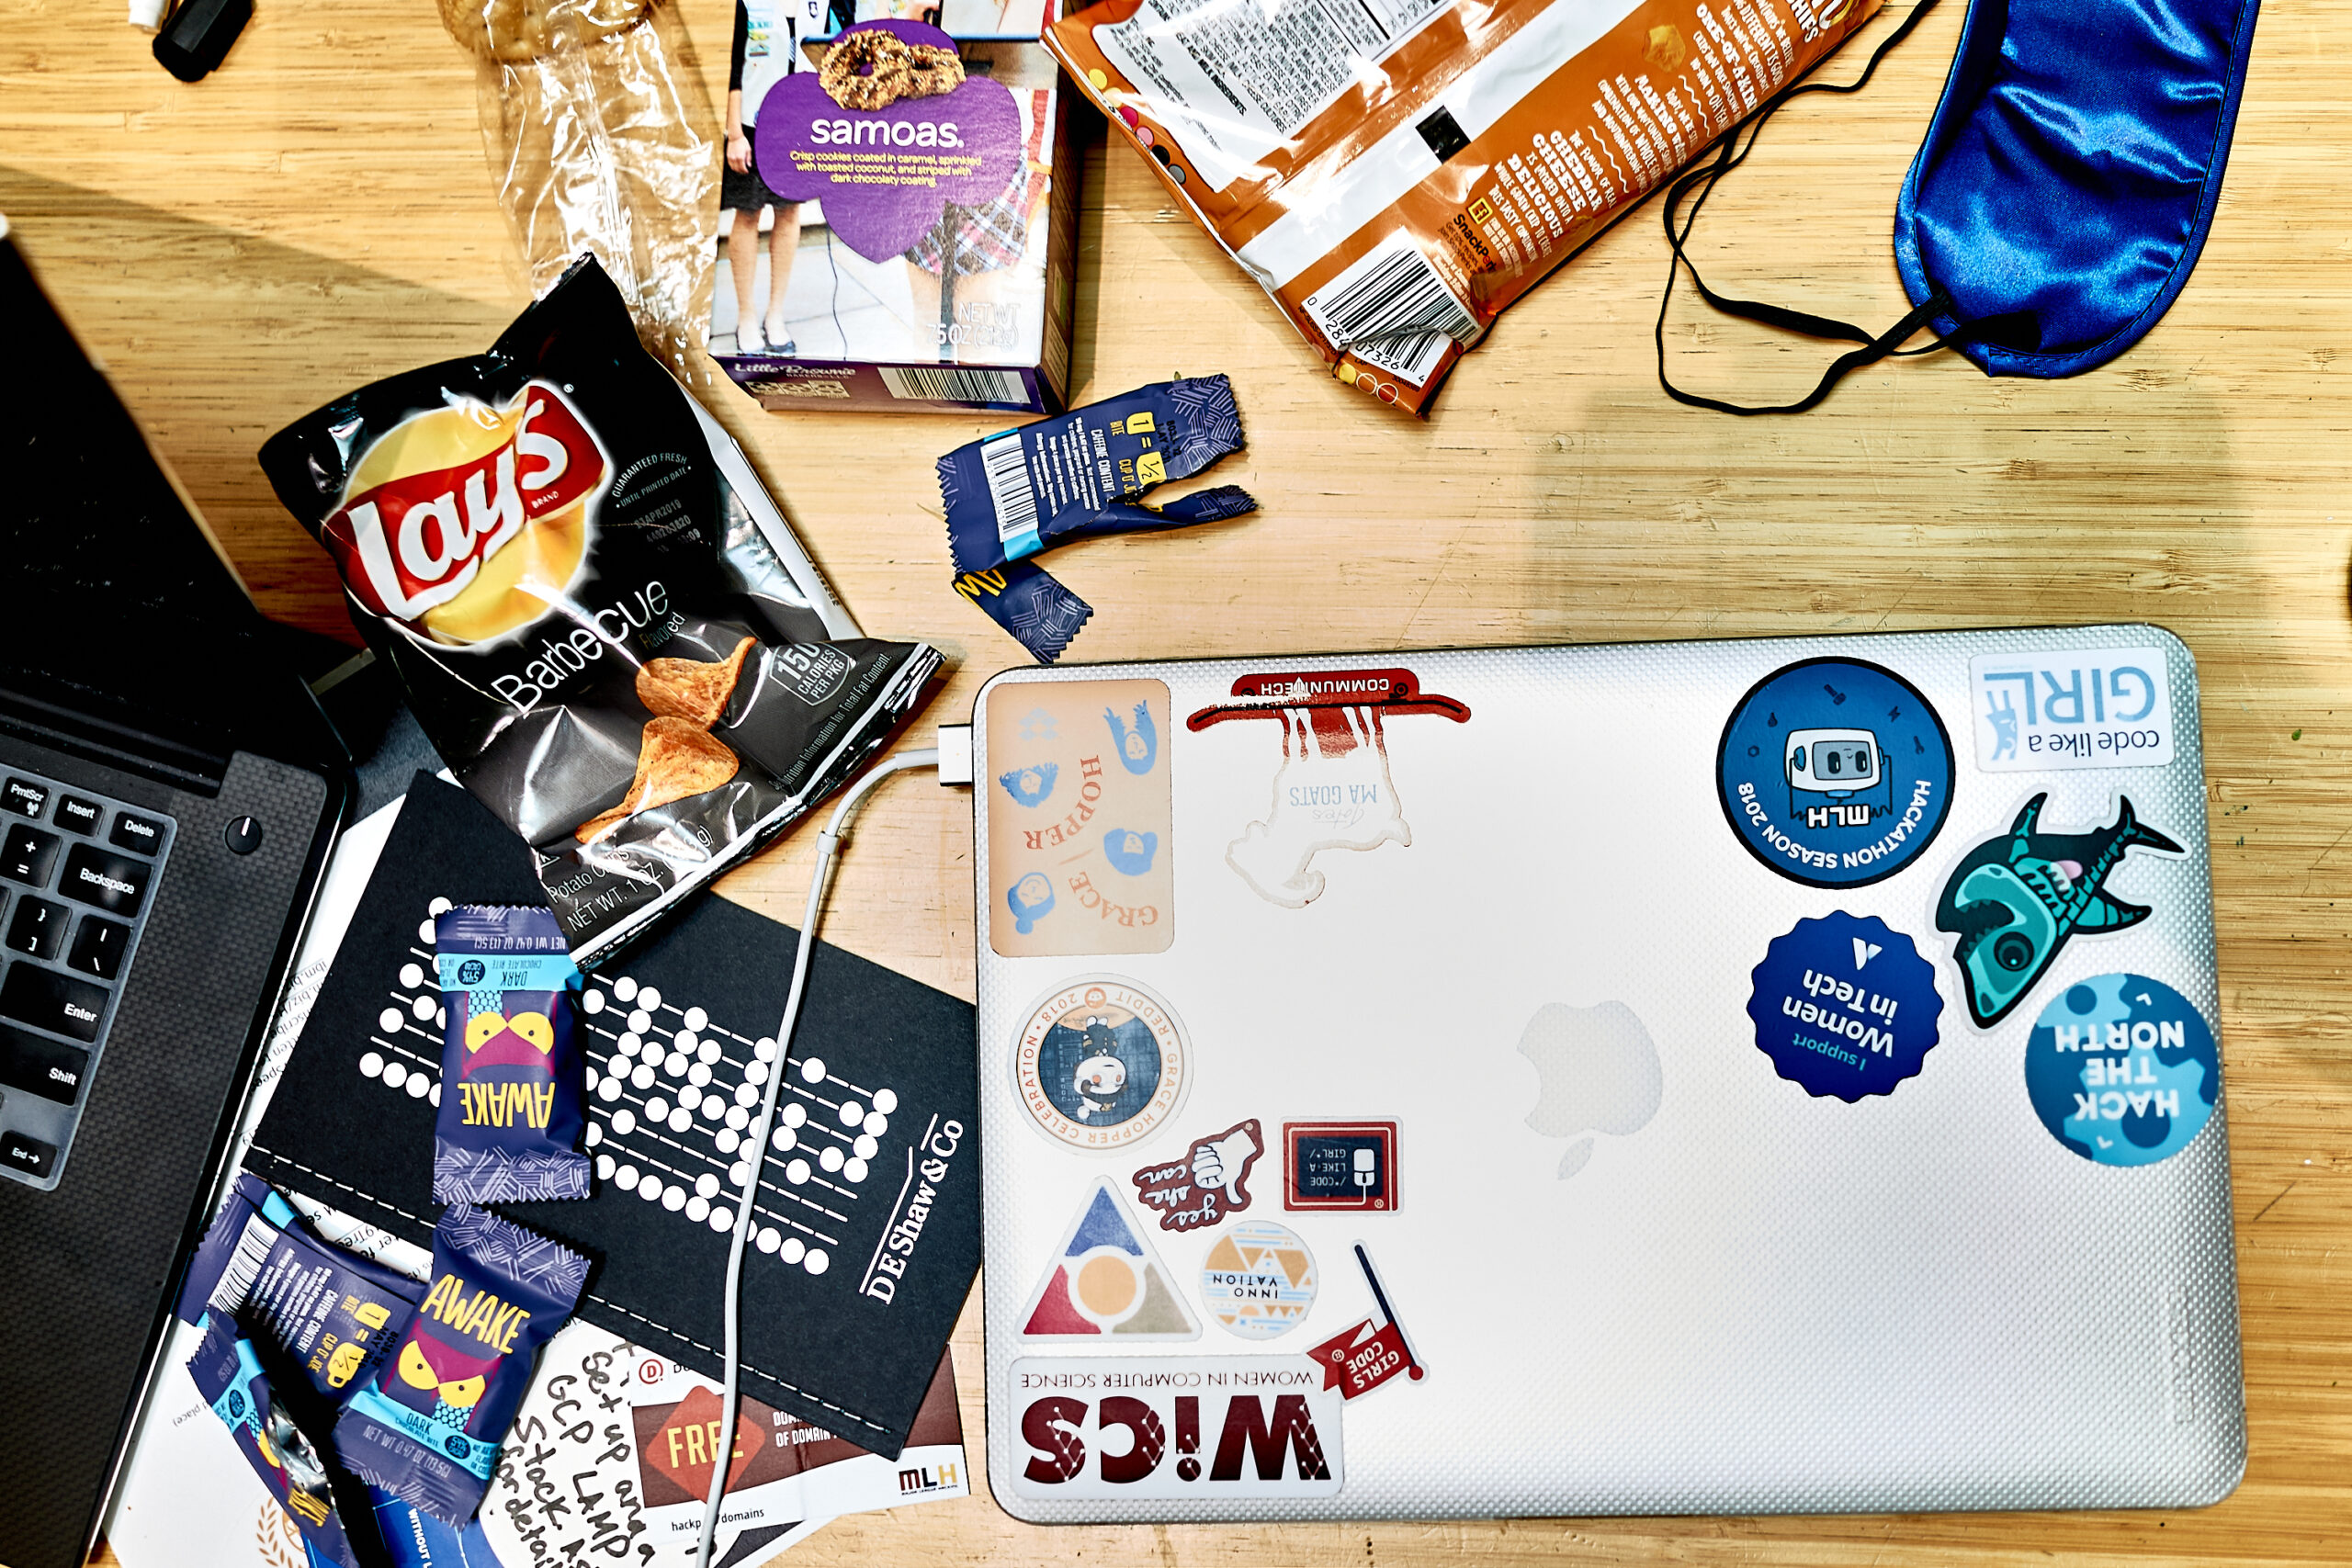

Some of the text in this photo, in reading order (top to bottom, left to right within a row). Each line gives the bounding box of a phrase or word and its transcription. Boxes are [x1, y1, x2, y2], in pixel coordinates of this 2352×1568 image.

[1737, 4, 1781, 66] DIFFERENT IS
[1705, 94, 1723, 112] OH
[789, 150, 982, 167] Crisp cookies coated in caramel, sprinkled
[796, 161, 972, 177] with toasted coconut, and striped with
[1529, 130, 1588, 213] CHEESE
[1546, 128, 1604, 211] CHEDDAR
[1567, 129, 1611, 189] THE FLAVOR OF
[829, 173, 937, 188] dark chocolaty coating.
[1491, 160, 1516, 189] WHOLE
[1508, 185, 1532, 213] GRAIN
[1505, 152, 1566, 239] DELICIOUS
[1523, 151, 1572, 218] IS LAYERED ONTO
[1498, 199, 1522, 228] TASTY
[1090, 427, 1115, 493] CAFFEINE CONTENT
[1109, 419, 1134, 475] BITE CUP
[611, 450, 686, 498] GUARANTEED FRESH
[618, 465, 688, 507] UNTIL PRINTED DATE
[529, 489, 560, 511] BRAND
[490, 577, 665, 712] Barbecue
[637, 610, 686, 651] Flavored
[796, 649, 837, 696] CALORIES
[809, 657, 846, 701] PER PKG
[799, 650, 893, 765] Information Total Fat Content.
[1983, 666, 2156, 726] GIRL
[2029, 729, 2160, 758] code like a
[67, 801, 95, 819] Insert
[1288, 783, 1377, 807] MA GOATS
[124, 820, 154, 838] Delete
[1737, 779, 1931, 869] HACKATHON SEASON 2018
[1807, 805, 1870, 828] MLH
[1023, 755, 1159, 928] GRACE HOPPER
[79, 868, 135, 895] Backspace
[546, 865, 594, 905] Potato
[533, 935, 566, 950] NET WT
[460, 969, 481, 982] 54%
[463, 960, 481, 971] CACAO
[500, 970, 527, 986] DARK
[506, 958, 542, 970] CHOCOLATE
[1803, 967, 1898, 1026] in Tech
[63, 1004, 97, 1022] Enter
[1782, 996, 1894, 1057] Women
[1789, 1031, 1867, 1072] I support
[2054, 1021, 2185, 1053] NORTH
[48, 1067, 77, 1086] Shift
[1021, 990, 1180, 1145] REDDIT GRACE HOPPER CELEBRATION 2018
[2086, 1058, 2157, 1085] THE
[456, 1081, 556, 1129] AWAKE
[2074, 1090, 2179, 1120] HACK
[11, 1146, 28, 1159] End
[1320, 1161, 1346, 1172] LIKE
[1138, 1164, 1186, 1183] can
[1144, 1185, 1191, 1207] she
[1166, 1193, 1217, 1225] yes
[1213, 1273, 1278, 1286] VATION
[1233, 1286, 1279, 1299] INNO
[293, 1287, 339, 1355] CAFFEINE CONTENT
[319, 1292, 360, 1351] BITE CUP
[418, 1272, 532, 1355] AWAKE
[1346, 1340, 1384, 1372] CODE
[1355, 1349, 1400, 1390] GIRLS
[582, 1351, 623, 1413] Set
[1020, 1371, 1313, 1388] WOMEN IN COMPUTER SCIENCE
[361, 1423, 399, 1452] NET WT
[404, 1410, 435, 1436] DARK
[595, 1424, 630, 1465] up
[775, 1431, 791, 1448] OF
[495, 1446, 525, 1493] for
[548, 1375, 630, 1558] GCP LAMP
[898, 1462, 957, 1491] MLH
[407, 1506, 431, 1561] WITHOUT
